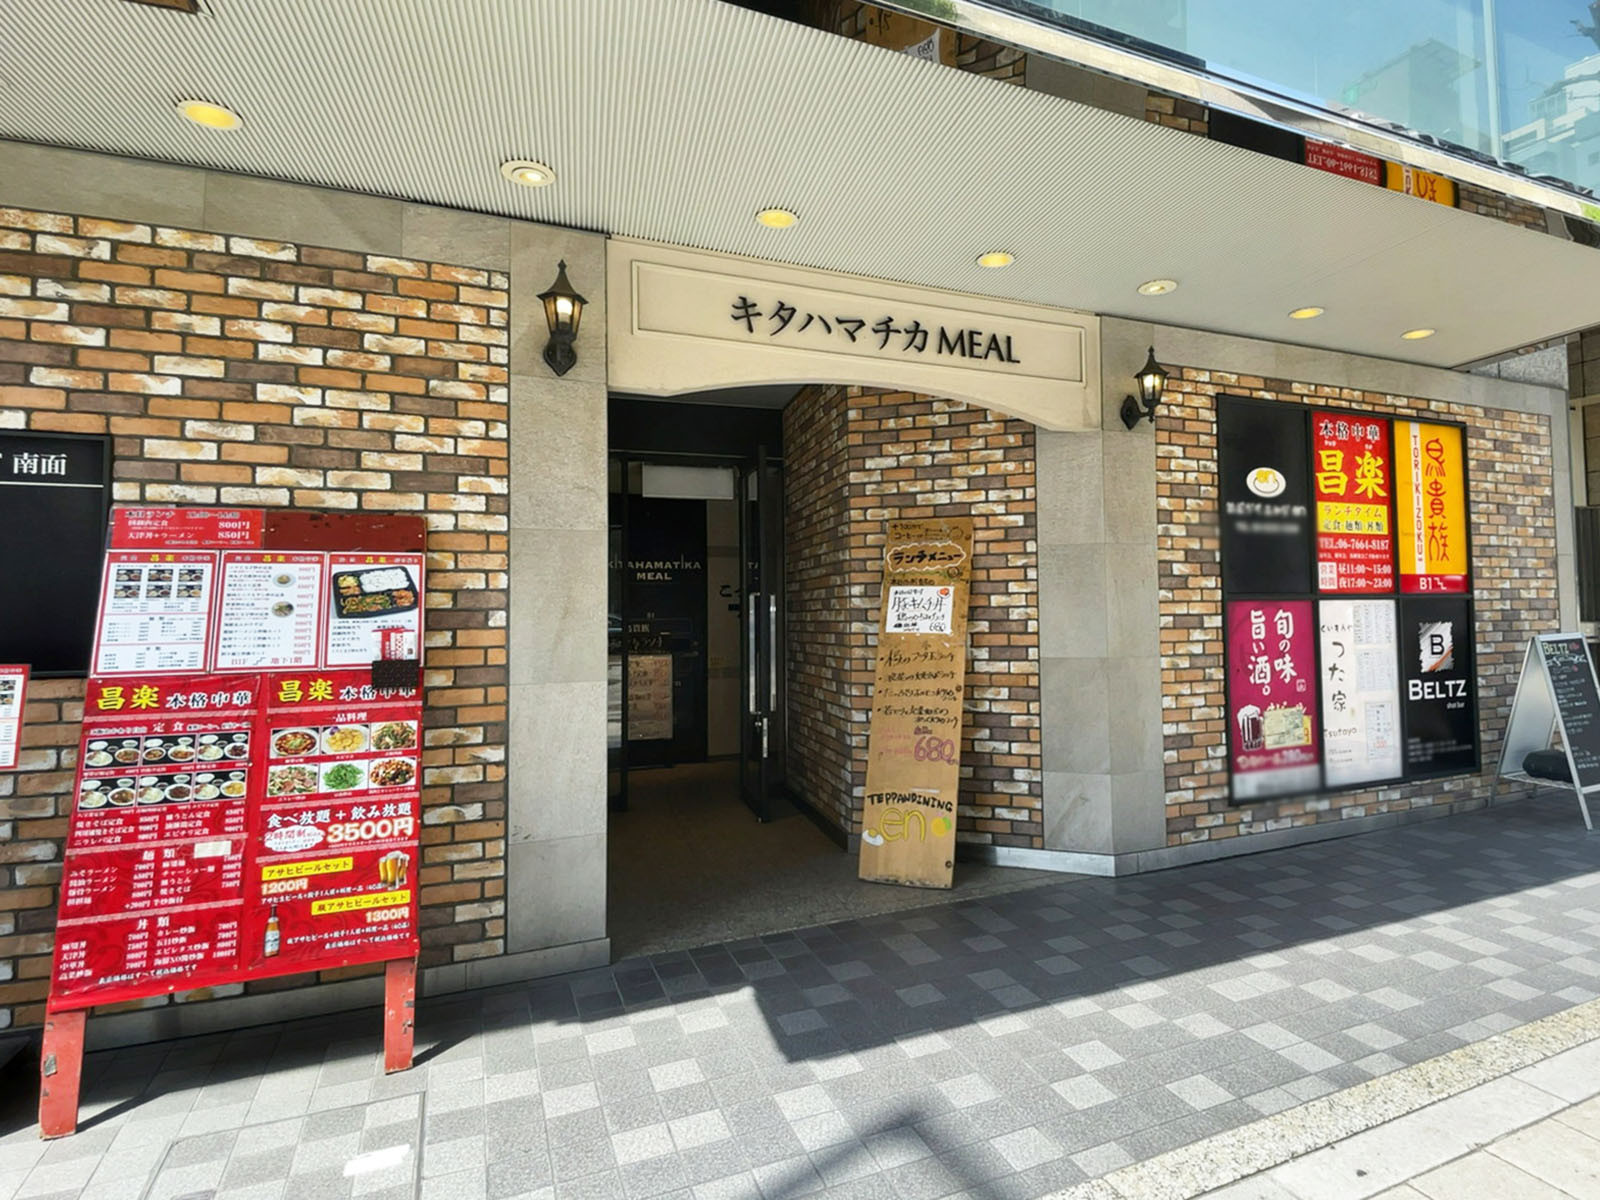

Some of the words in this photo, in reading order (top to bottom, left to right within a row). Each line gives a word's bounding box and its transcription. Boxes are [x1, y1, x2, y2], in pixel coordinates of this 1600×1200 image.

[731, 296, 929, 352] キタハマチカ
[938, 326, 1020, 364] MEAL
[1319, 419, 1380, 443] 本格中華
[13, 452, 67, 475] 南面
[1315, 449, 1388, 499] 昌楽
[1324, 504, 1382, 518] ランチタイム
[1425, 438, 1450, 561] 鳥貴族
[894, 550, 962, 566] ランチメニュー
[636, 572, 672, 581] MEAL
[1419, 577, 1433, 590] B1
[1248, 609, 1271, 696] 旨い酒。
[1274, 609, 1297, 684] 旬の味
[1429, 633, 1445, 656] B
[1542, 642, 1569, 656] BELTZ
[1328, 641, 1347, 712] つた家
[97, 685, 160, 710] 昌楽
[165, 690, 251, 709] 本格中華
[278, 679, 334, 703] 昌楽
[1408, 679, 1467, 701] BELTZ
[867, 792, 953, 812] TEPPANDINING
[267, 809, 330, 829] 食べ放題
[350, 802, 412, 820] 飲み放題
[881, 807, 926, 842] en
[326, 816, 414, 843] 3500円
[267, 860, 349, 877] アサヒビールセット
[260, 877, 309, 895] 1200円
[366, 907, 410, 924] 1300円
